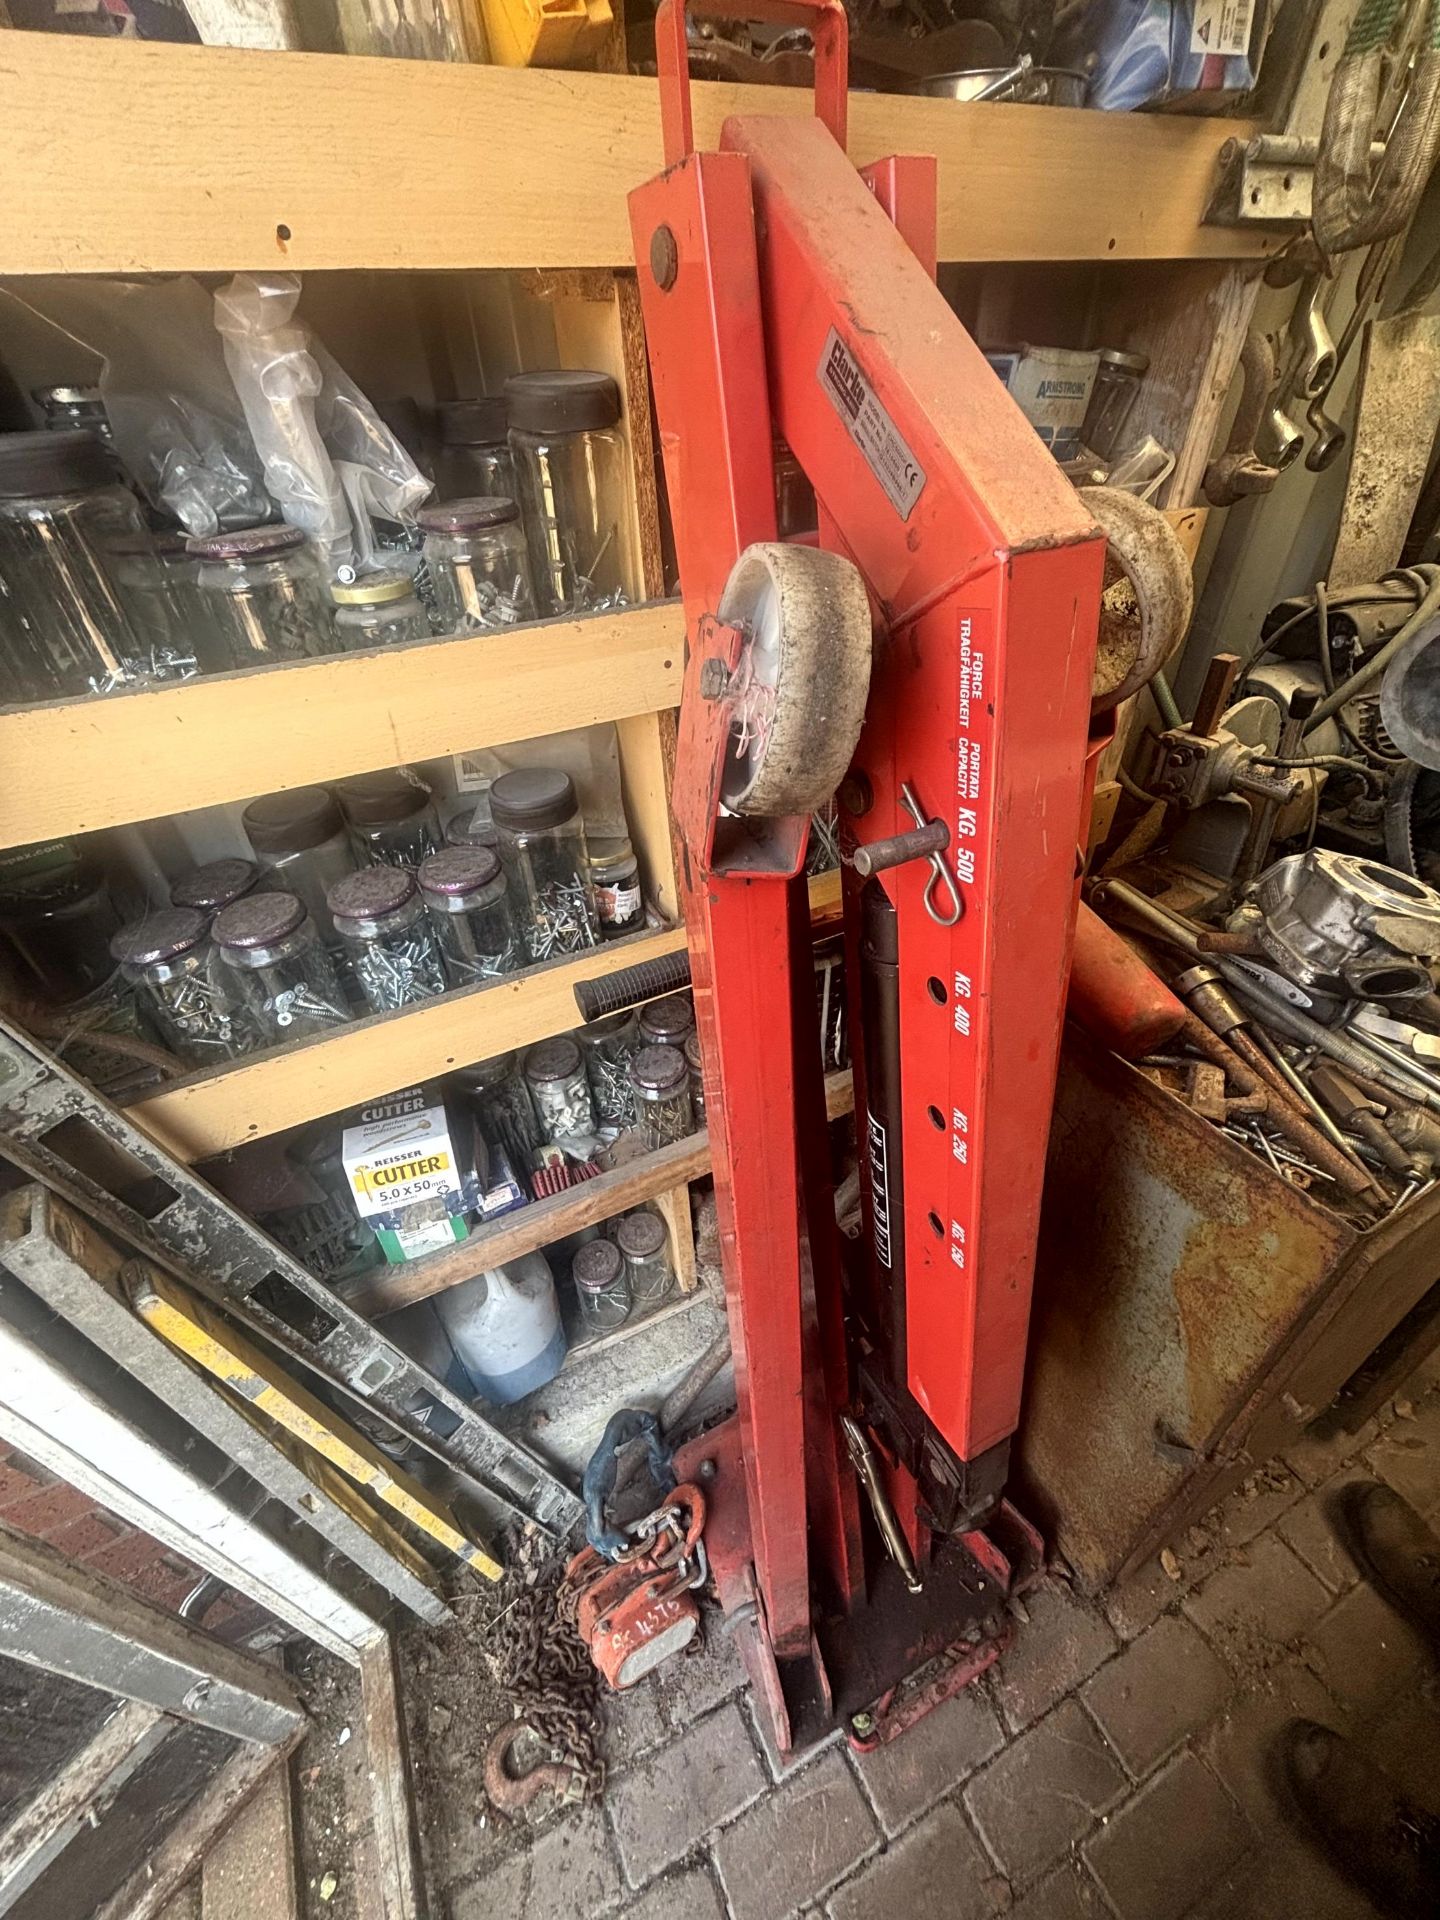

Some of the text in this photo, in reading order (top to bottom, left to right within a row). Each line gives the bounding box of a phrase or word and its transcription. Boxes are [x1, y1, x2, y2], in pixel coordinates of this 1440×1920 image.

[830, 339, 866, 406] Clarke
[1036, 380, 1085, 399] ARMSTRONG
[959, 617, 972, 729] TRAGFÄHIGKEIT
[972, 651, 983, 700] FORCE
[957, 737, 968, 800] CAPACITY
[969, 742, 980, 799] PORTATA
[957, 806, 976, 884] KG. 500
[954, 970, 971, 1036] KG. 400
[361, 1097, 425, 1122] CUTTER
[952, 1107, 968, 1164] KG. 250
[373, 1156, 442, 1186] CUTTER
[374, 1150, 422, 1167] REISSER
[380, 1188, 400, 1202] 5.0
[403, 1186, 412, 1196] x
[951, 1219, 965, 1269] KG. 150
